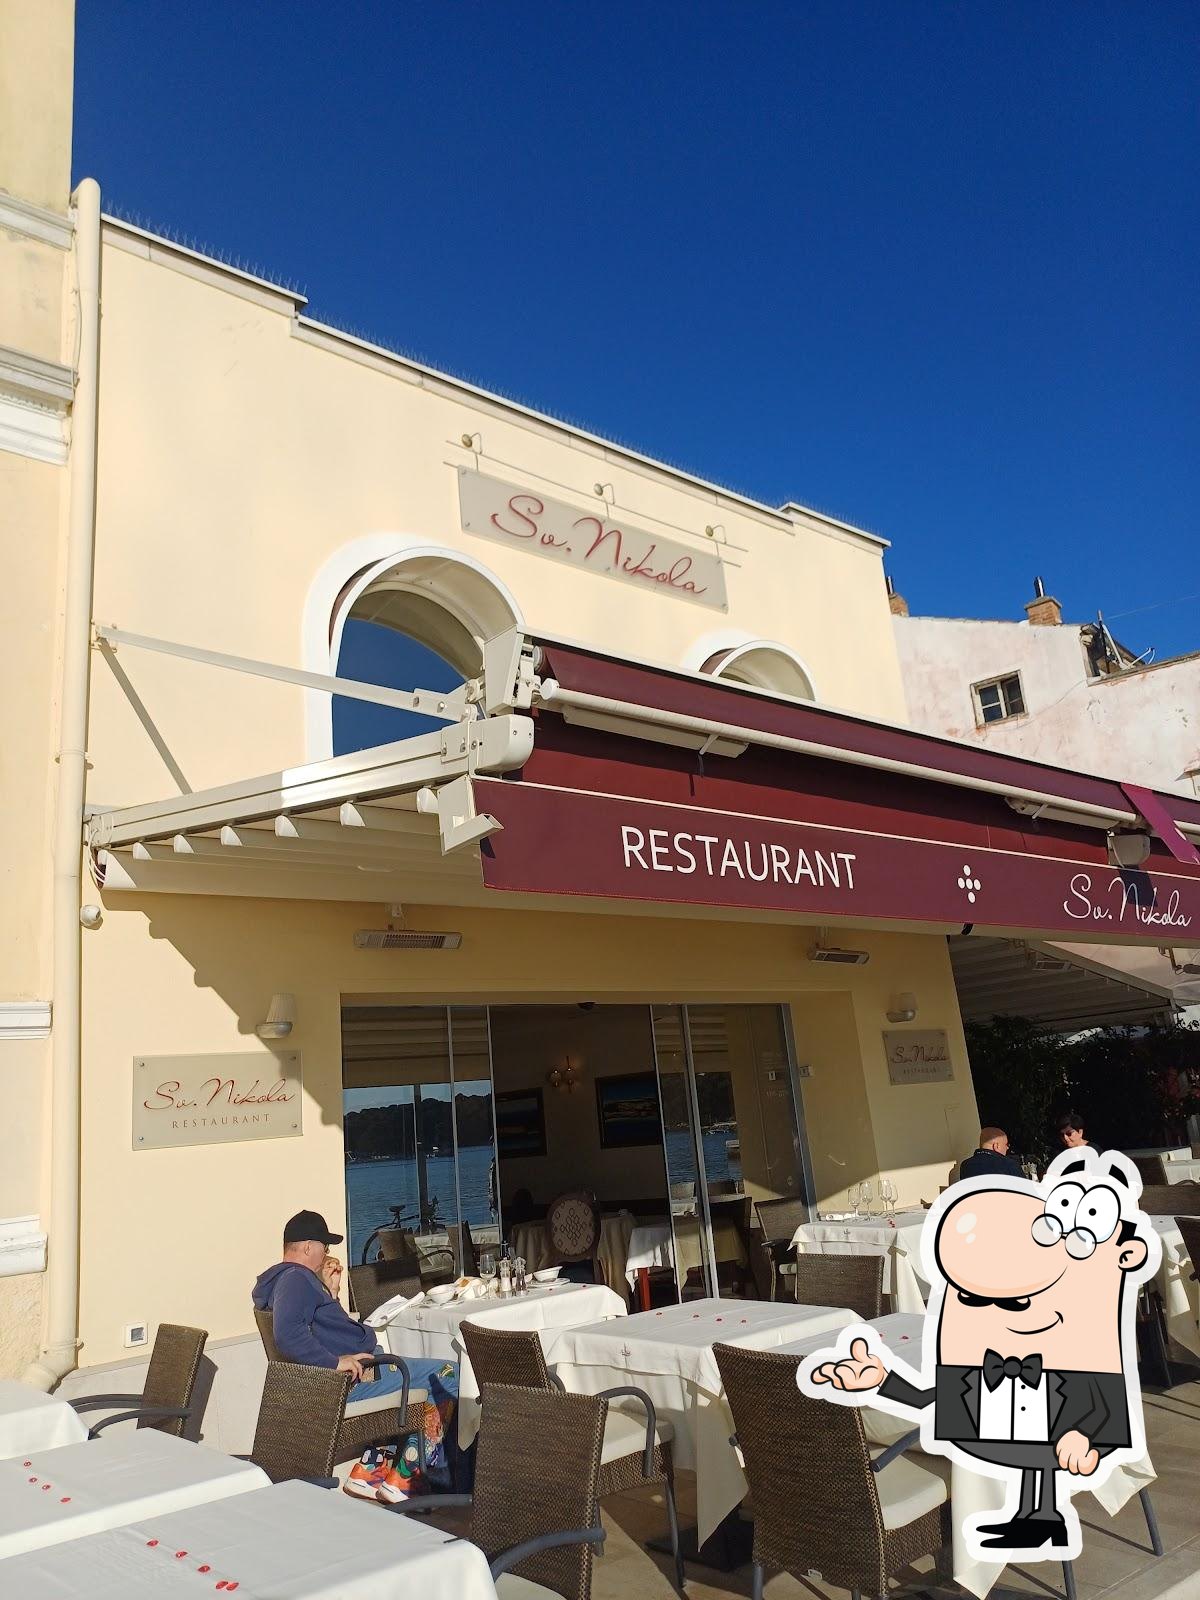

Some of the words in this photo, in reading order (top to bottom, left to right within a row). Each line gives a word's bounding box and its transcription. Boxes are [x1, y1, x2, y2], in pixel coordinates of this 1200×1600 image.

[491, 494, 572, 553] Sv.
[572, 516, 708, 595] Nikola
[620, 825, 857, 889] RESTAURANT
[1063, 873, 1113, 920] Sv.
[1108, 876, 1192, 927] Nikola
[143, 1080, 198, 1110] Sv.
[200, 1077, 296, 1107] Nikola
[171, 1113, 271, 1129] RESTAURANT
